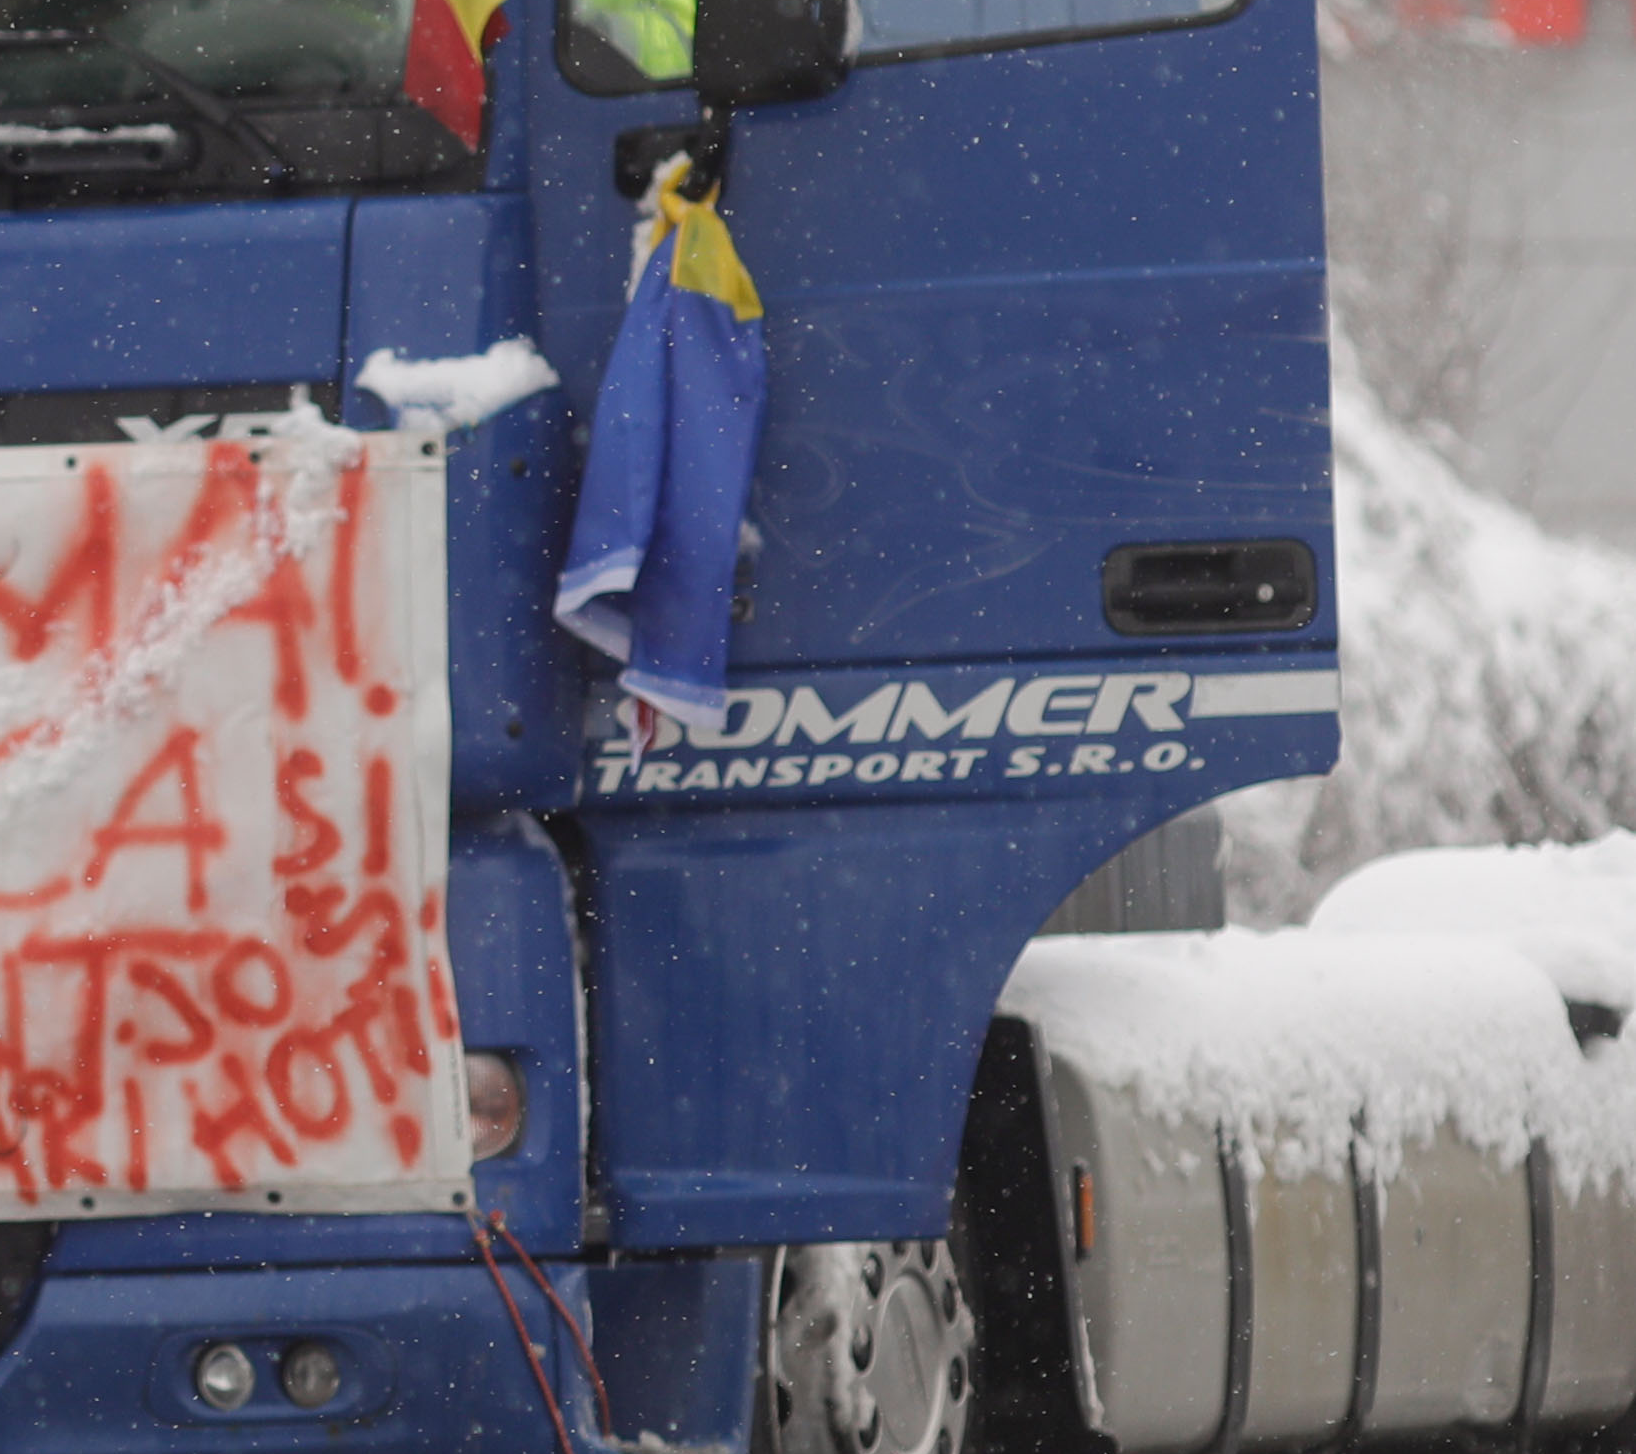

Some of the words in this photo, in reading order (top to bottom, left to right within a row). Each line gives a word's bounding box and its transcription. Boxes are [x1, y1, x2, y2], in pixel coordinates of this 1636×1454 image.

[603, 671, 1192, 755] SOMMER
[594, 748, 988, 795] TRANSPORT
[1004, 741, 1206, 779] S.R.O.
